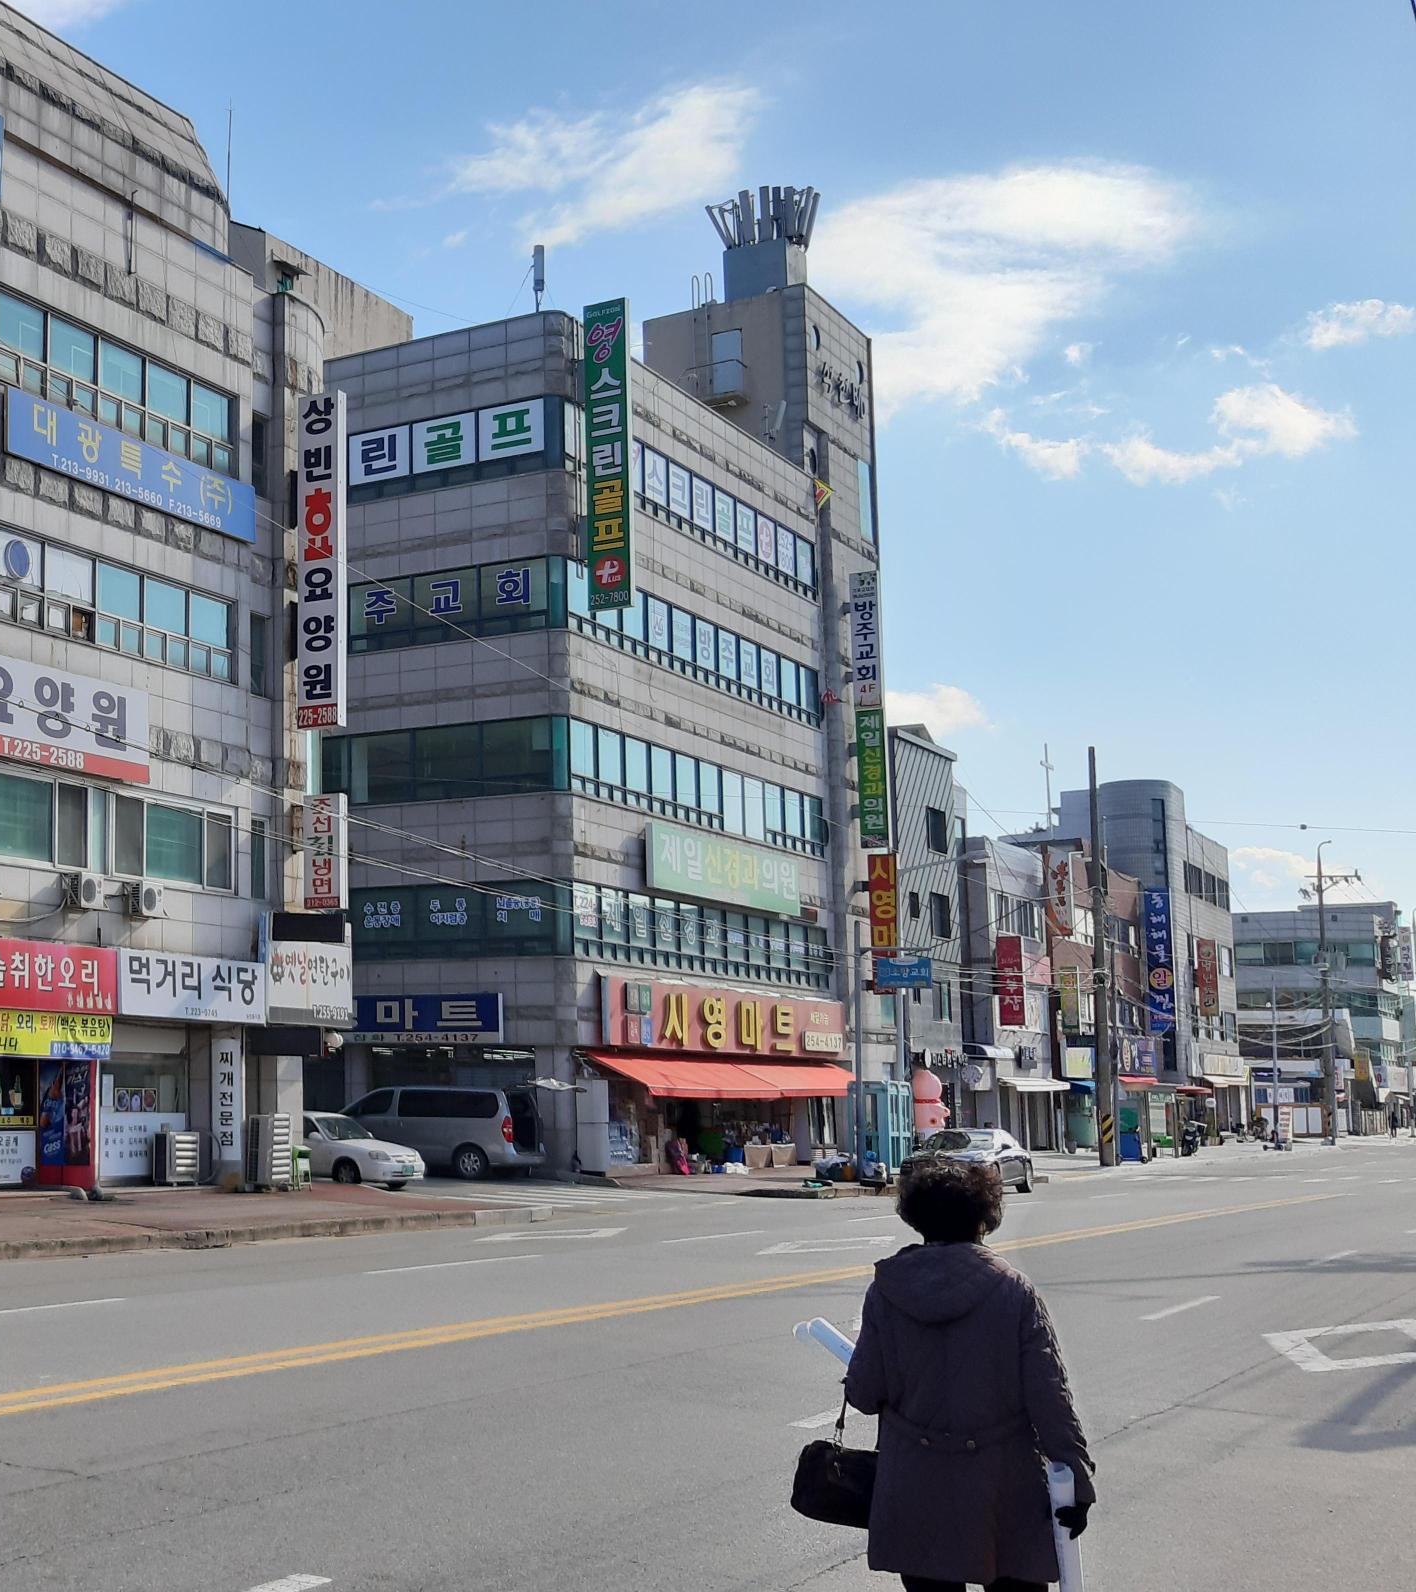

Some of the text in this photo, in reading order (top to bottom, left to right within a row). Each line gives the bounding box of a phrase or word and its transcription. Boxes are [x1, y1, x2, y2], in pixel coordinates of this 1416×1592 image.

[302, 397, 334, 701] 상빈효요양원
[590, 590, 629, 606] 252-7800
[854, 600, 877, 681] 방주교회
[860, 683, 876, 694] 4F
[298, 705, 337, 727] 225-2588
[1, 737, 85, 770] T.225-2588
[659, 832, 797, 899] 제일신경과의원
[128, 955, 257, 1006] 먹거리 식당
[393, 1032, 479, 1043] T.254-4137
[663, 993, 796, 1055] 시영마트
[806, 1034, 842, 1049] 254-4137
[218, 1051, 234, 1147] 찌개전문점
